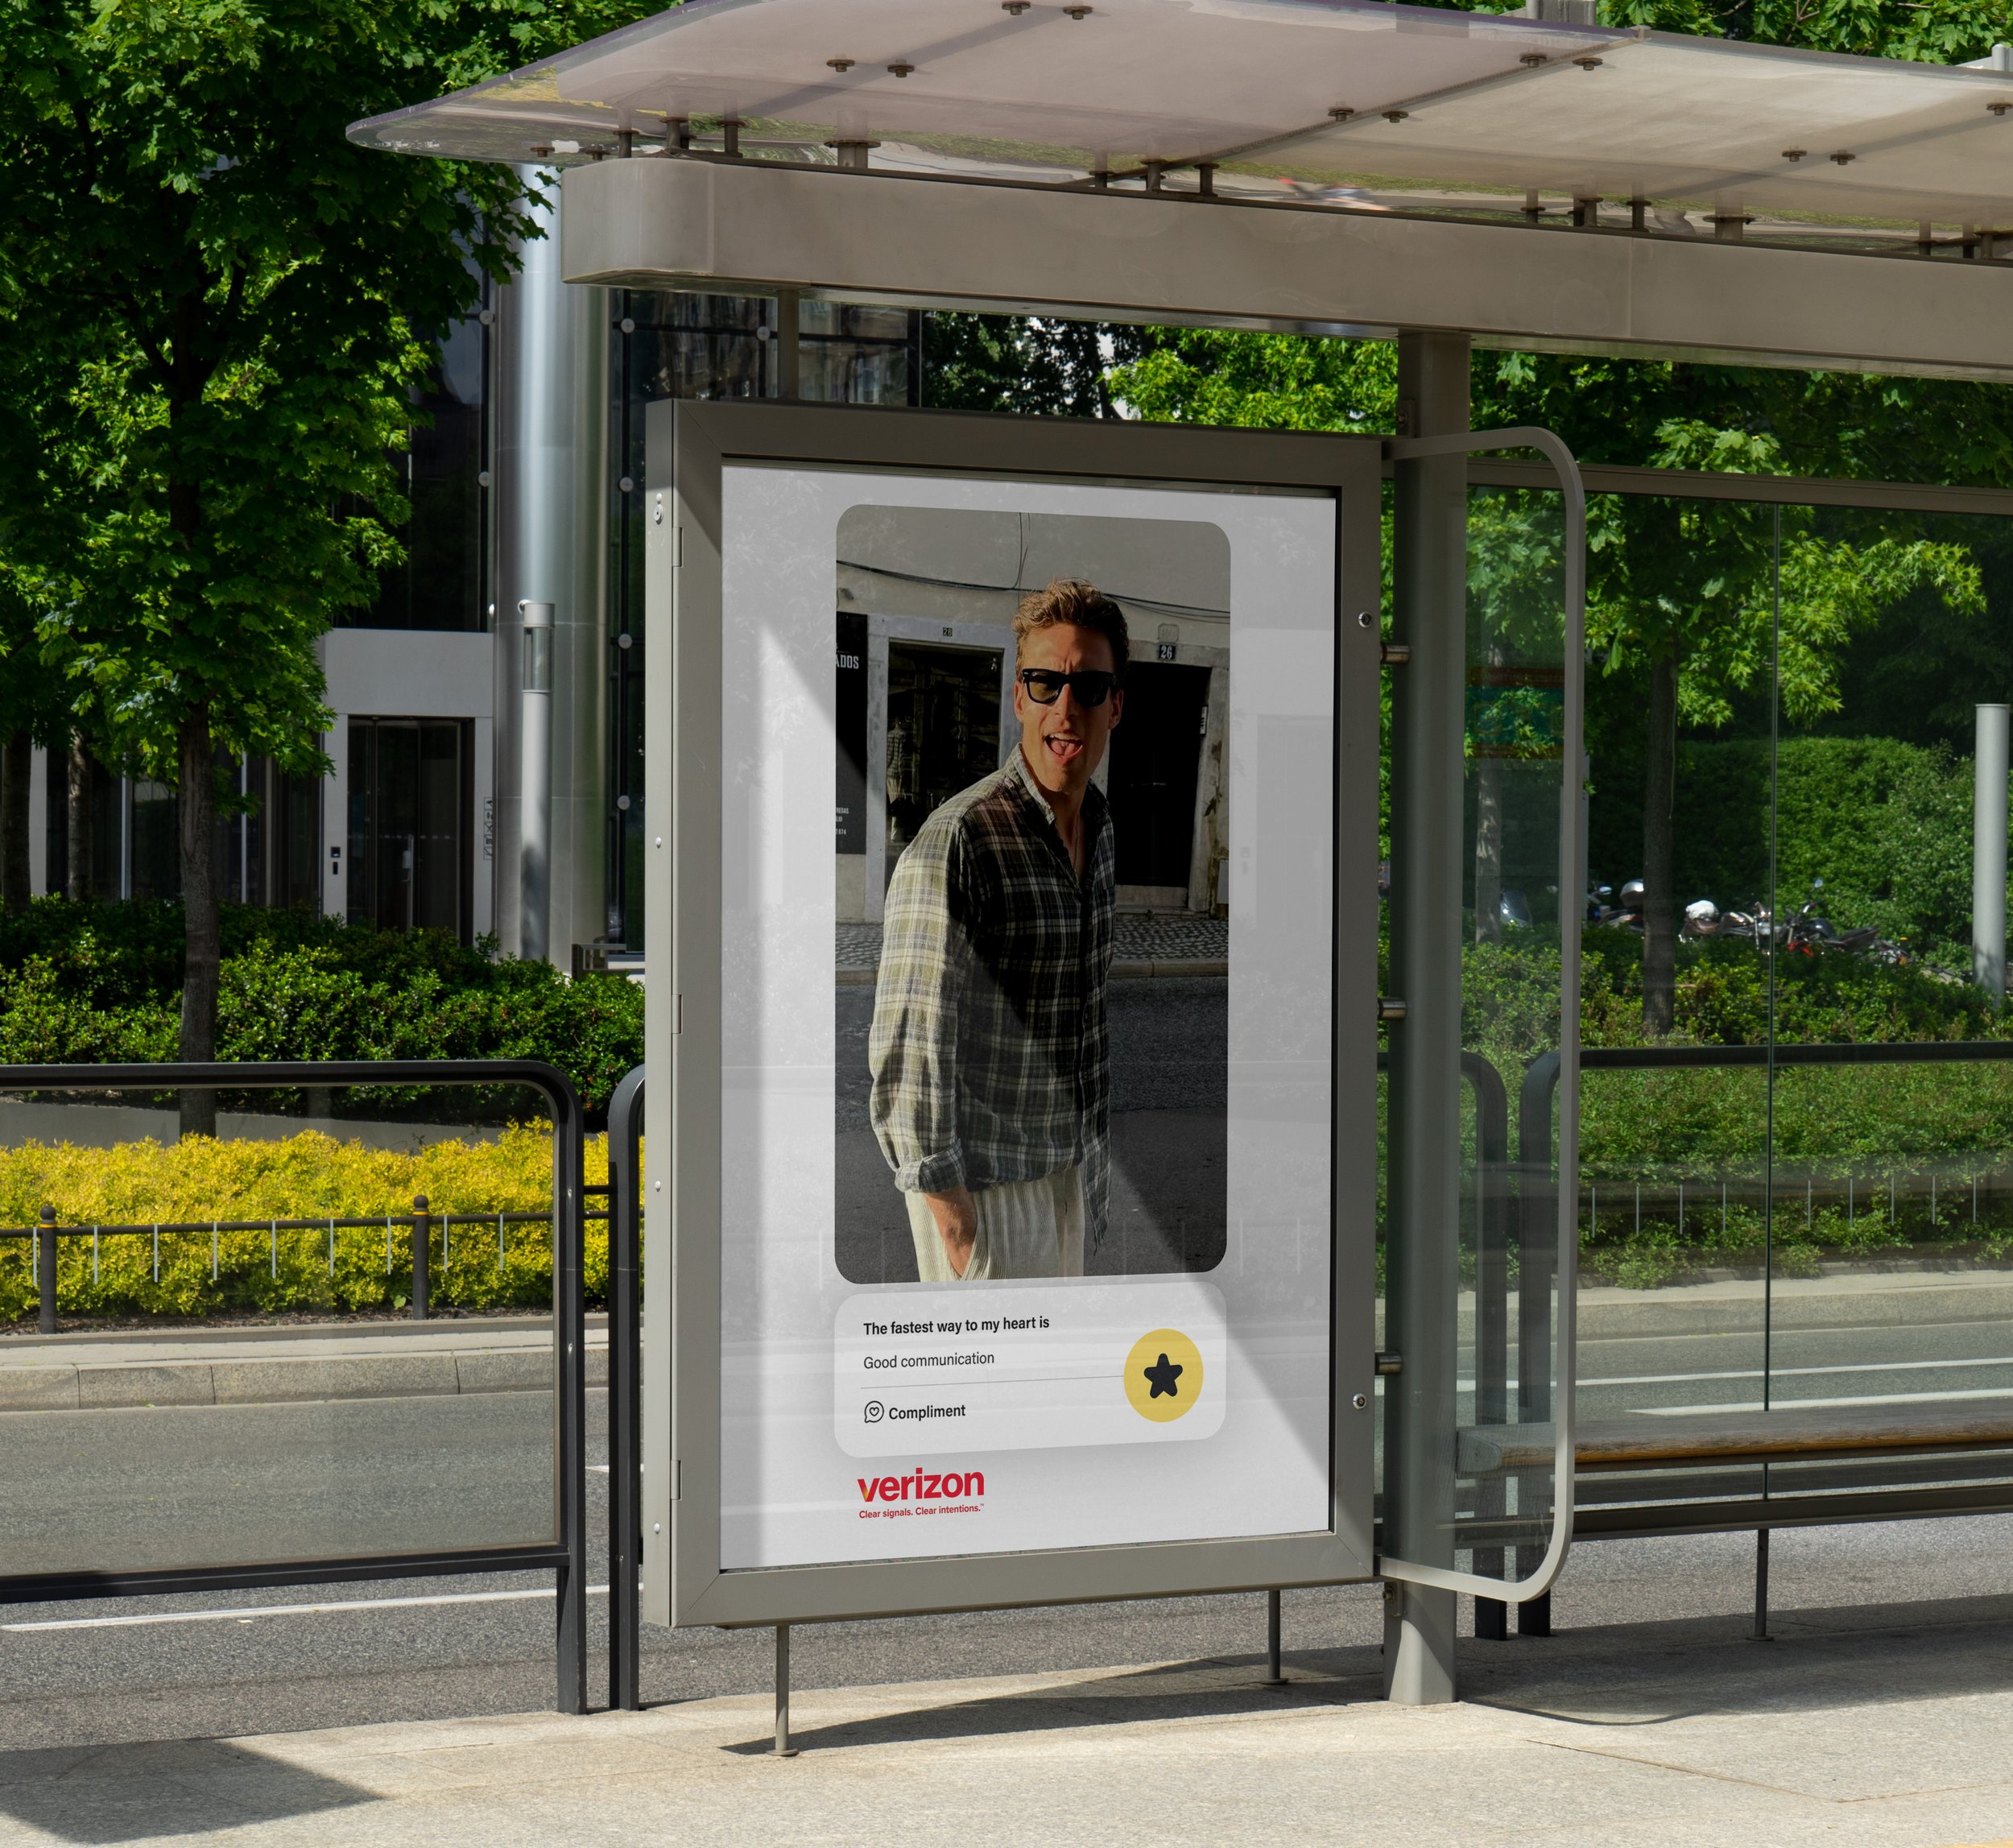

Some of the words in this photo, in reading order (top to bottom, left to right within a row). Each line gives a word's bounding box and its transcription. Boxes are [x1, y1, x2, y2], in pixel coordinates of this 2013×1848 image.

[1161, 645, 1172, 659] 26
[863, 1322, 887, 1335] The
[891, 1321, 934, 1334] fastest
[937, 1321, 962, 1335] way
[965, 1318, 978, 1331] to
[981, 1320, 1000, 1333] my
[1003, 1317, 1036, 1330] heart
[1040, 1316, 1050, 1328] is
[863, 1355, 897, 1369] Good
[900, 1351, 994, 1367] communication
[889, 1404, 966, 1421] Compliment
[857, 1467, 985, 1503] verizon
[859, 1510, 881, 1519] Clear
[882, 1508, 913, 1519] signals.
[915, 1507, 937, 1515] Clear
